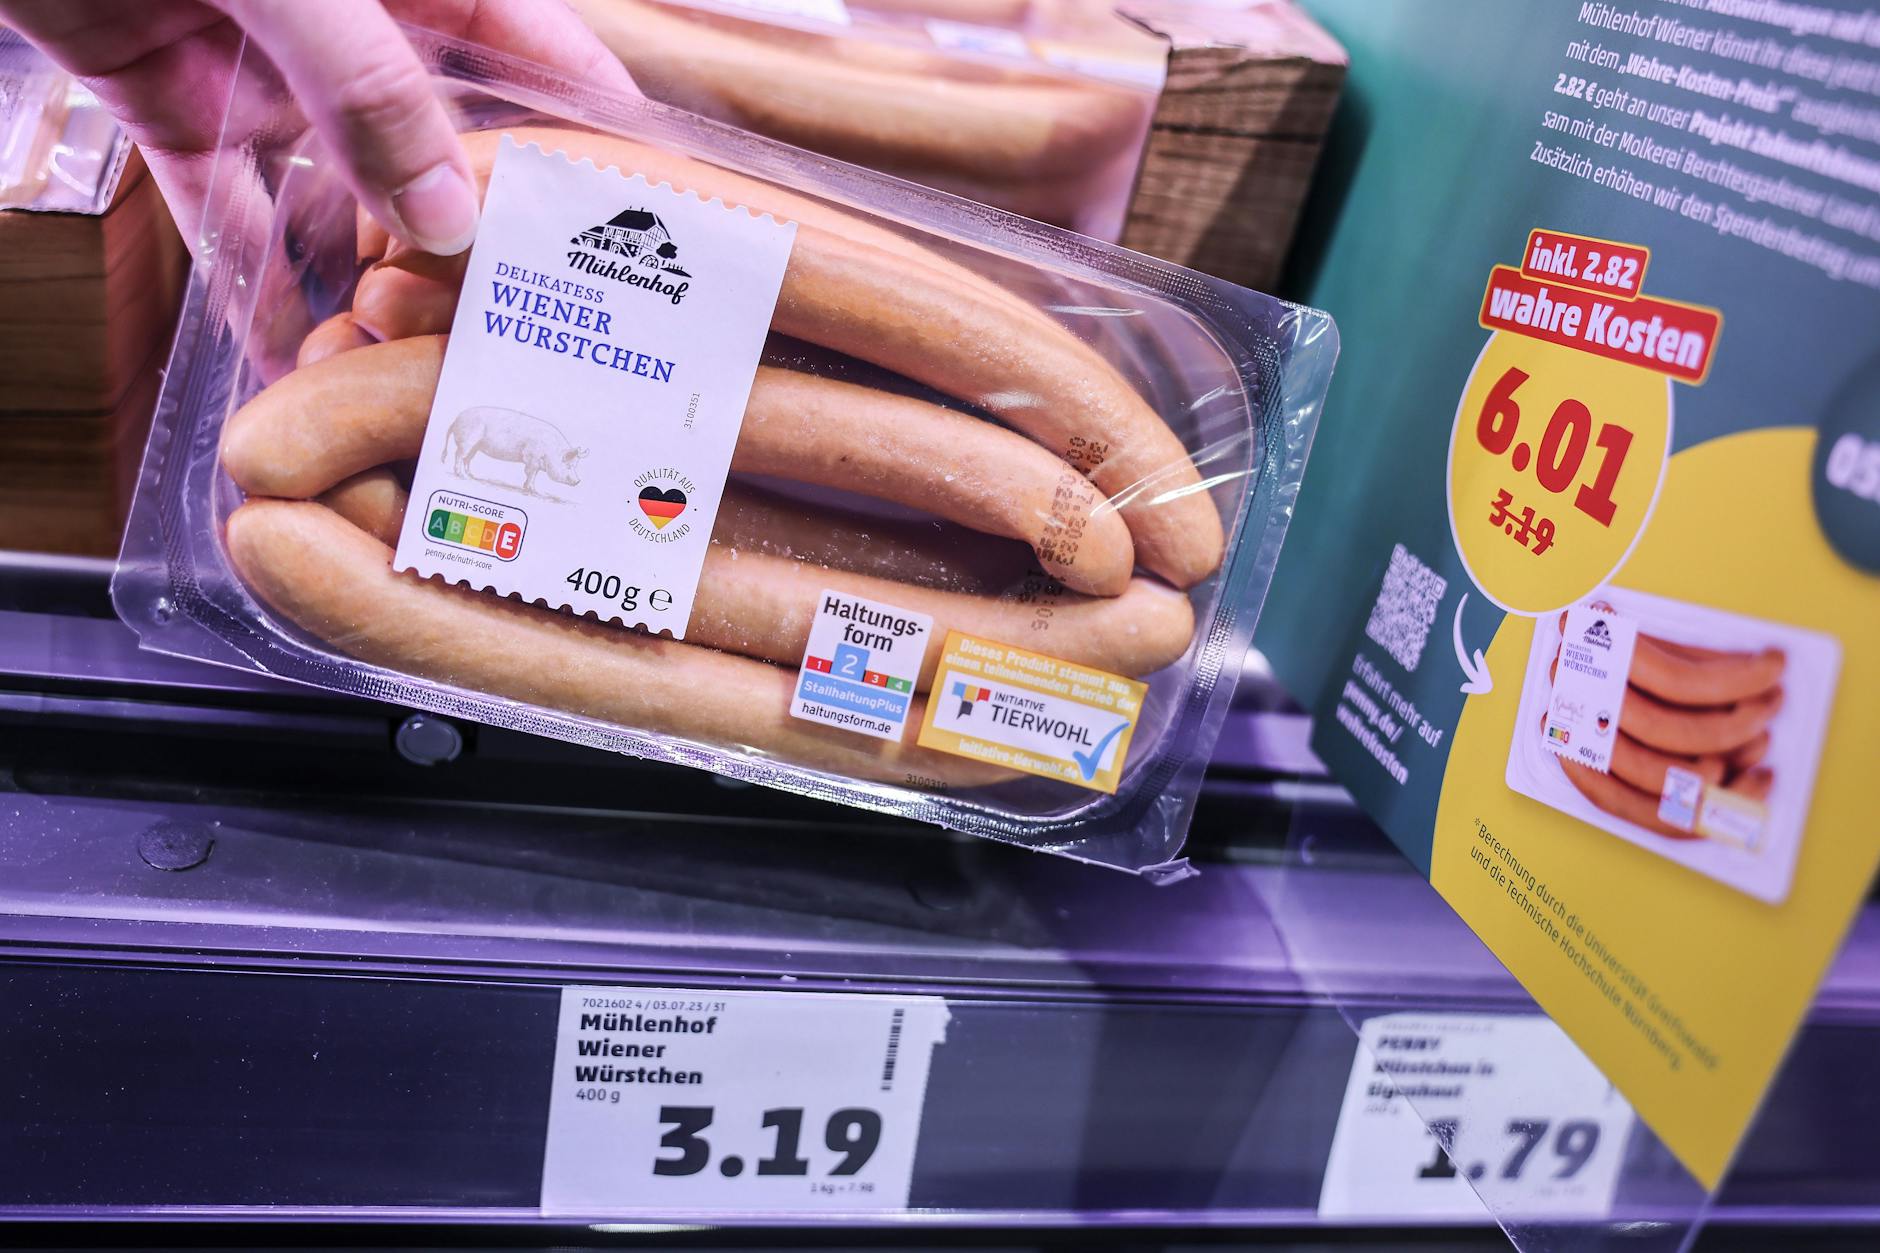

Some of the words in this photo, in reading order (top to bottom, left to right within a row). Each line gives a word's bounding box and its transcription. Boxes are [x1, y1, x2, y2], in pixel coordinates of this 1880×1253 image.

[1578, 1, 1658, 38] Mühlenhof
[1655, 16, 1714, 51] Wiener
[1710, 27, 1761, 64] könnt
[1566, 39, 1590, 62] mit
[1589, 43, 1620, 70] dem
[1554, 73, 1586, 99] 2.82
[1585, 82, 1598, 102] €
[1594, 88, 1629, 112] geht
[1627, 97, 1647, 117] an
[1647, 103, 1691, 130] unser
[1542, 110, 1569, 130] sam
[1569, 118, 1594, 140] mit
[1594, 123, 1619, 148] der
[1618, 131, 1684, 170] Molkerei
[1530, 141, 1593, 180] Zusätzlich
[1593, 166, 1654, 202] erhöhen
[1653, 186, 1682, 211] wir
[1680, 192, 1713, 223] den
[496, 263, 605, 304] DELIKATESS
[567, 250, 690, 305] Mühlenhof
[1528, 236, 1577, 279] inkl.
[1582, 252, 1639, 290] 2.82
[492, 282, 613, 336] WIENER
[1489, 286, 1583, 338] wahre
[1583, 303, 1706, 370] Kosten
[485, 311, 677, 384] WÜRSTCHEN
[683, 393, 700, 429] 3100351
[1476, 365, 1634, 528] 6.01
[633, 467, 680, 488] QUALITÄT
[678, 476, 696, 494] AUS
[438, 495, 505, 519] NUTRI-SCORE
[1488, 488, 1556, 556] 3.19
[431, 517, 444, 531] A
[450, 520, 462, 534] B
[500, 530, 517, 551] E
[628, 518, 691, 544] DEUTSCHLAND
[424, 548, 493, 570] penny.de/nutri-score
[822, 596, 924, 637] Haltungs-
[843, 623, 893, 653] form
[1566, 648, 1595, 665] WIENER
[840, 654, 859, 676] 2
[871, 674, 880, 683] 3
[959, 638, 1003, 662] Dieses
[1006, 651, 1057, 675] Produkt
[1058, 667, 1105, 686] stammt
[803, 680, 903, 714] StallhaltungPlus
[994, 691, 1046, 713] INITIATIVE
[1352, 652, 1393, 700] Erfahrt
[1388, 690, 1423, 728] mehr
[1417, 719, 1444, 748] auf
[801, 703, 892, 734] haltungsform.de
[991, 704, 1094, 747] TIERWOHL
[1470, 845, 1491, 871] und
[1489, 863, 1506, 888] die
[1505, 879, 1560, 943] Technische
[1559, 935, 1622, 1007] Hochschule
[1536, 883, 1568, 921] durch
[1566, 914, 1585, 938] die
[580, 1013, 718, 1034] Mühlenhof
[577, 1037, 667, 1058] Wiener
[575, 1064, 704, 1084] Würstchen
[576, 1088, 607, 1101] 400
[610, 1090, 621, 1103] g
[652, 1104, 883, 1178] 3.19
[1416, 1116, 1601, 1179] 1.79
